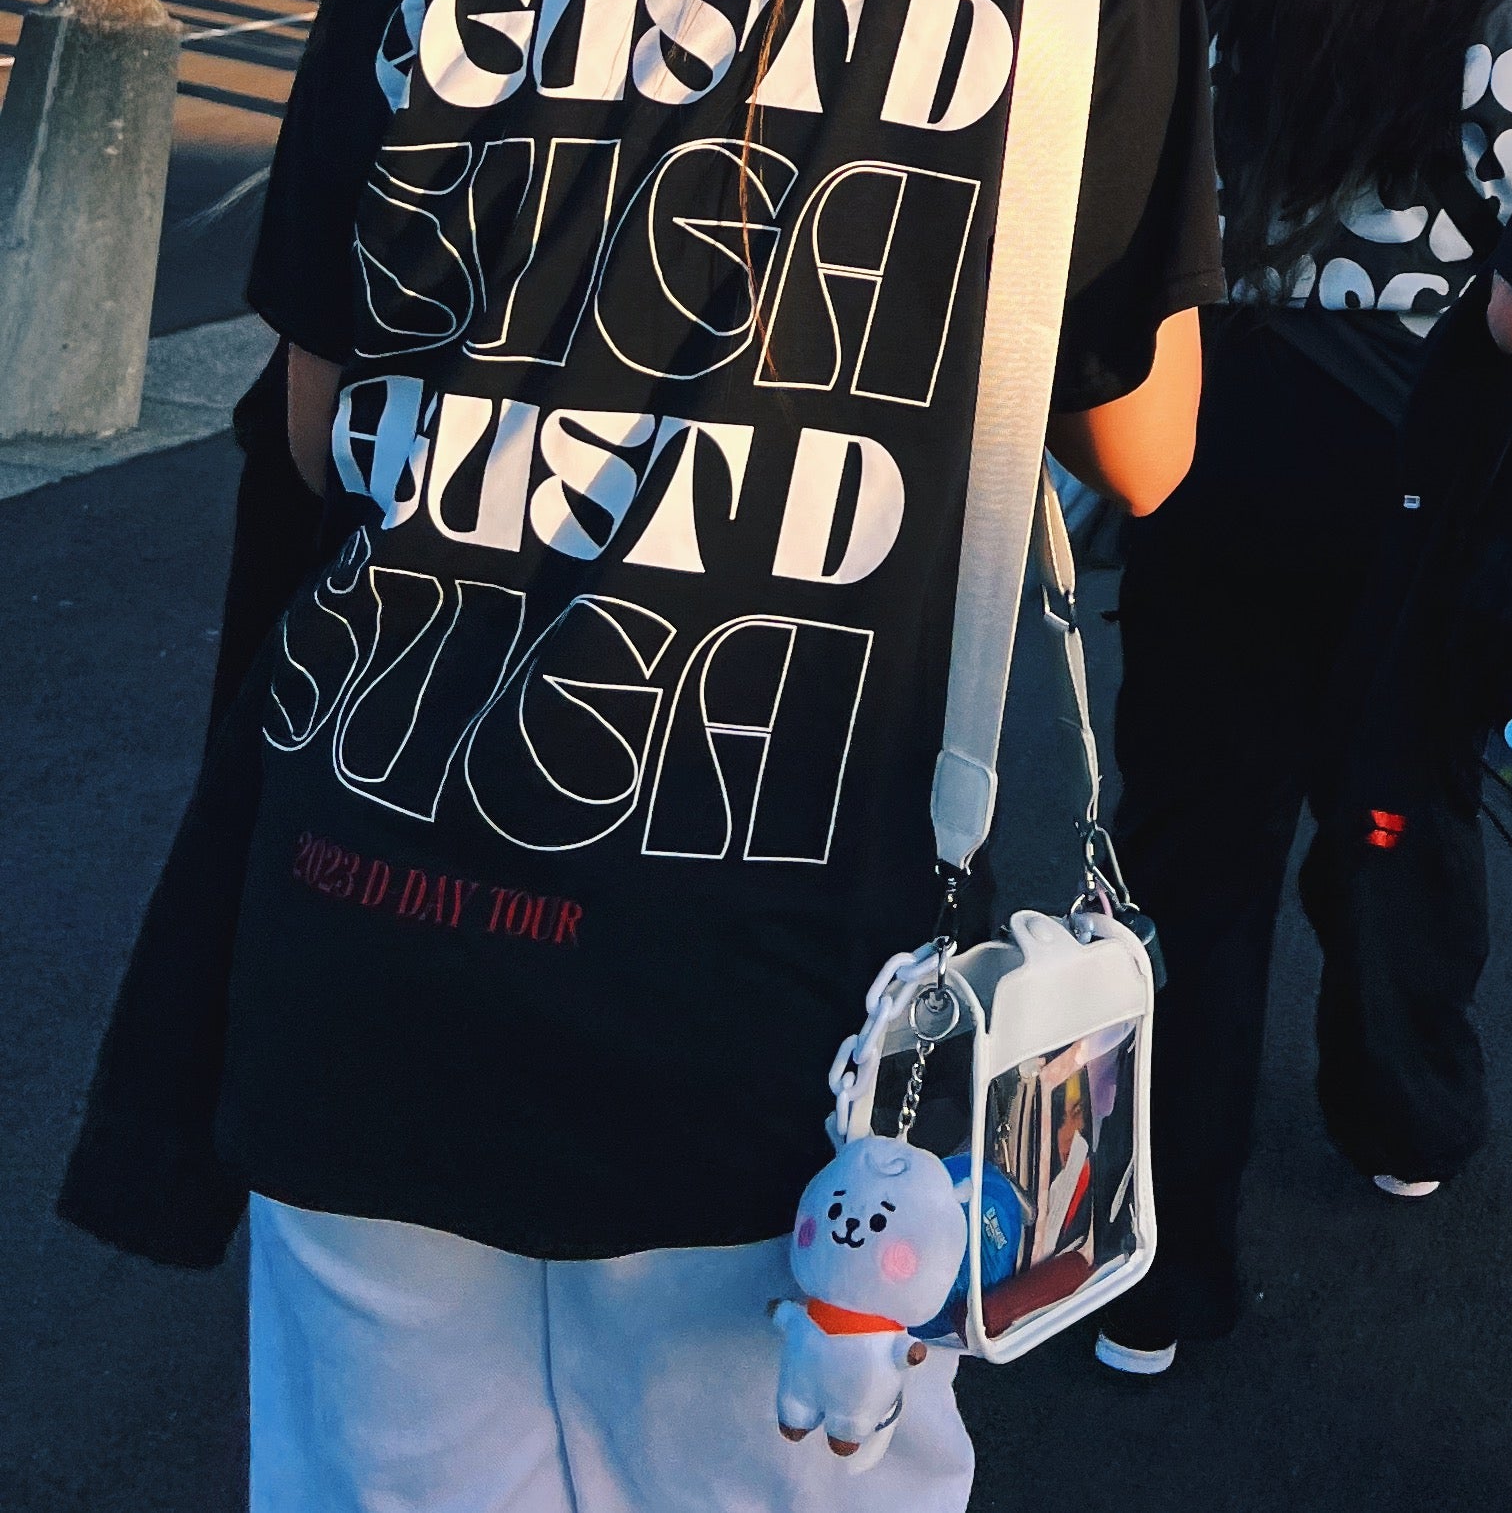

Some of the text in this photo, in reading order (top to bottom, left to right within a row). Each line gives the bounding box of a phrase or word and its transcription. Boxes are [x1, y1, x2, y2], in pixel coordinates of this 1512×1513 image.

[772, 427, 905, 585] D
[295, 830, 360, 898] 2023
[488, 886, 583, 948] TOUR
